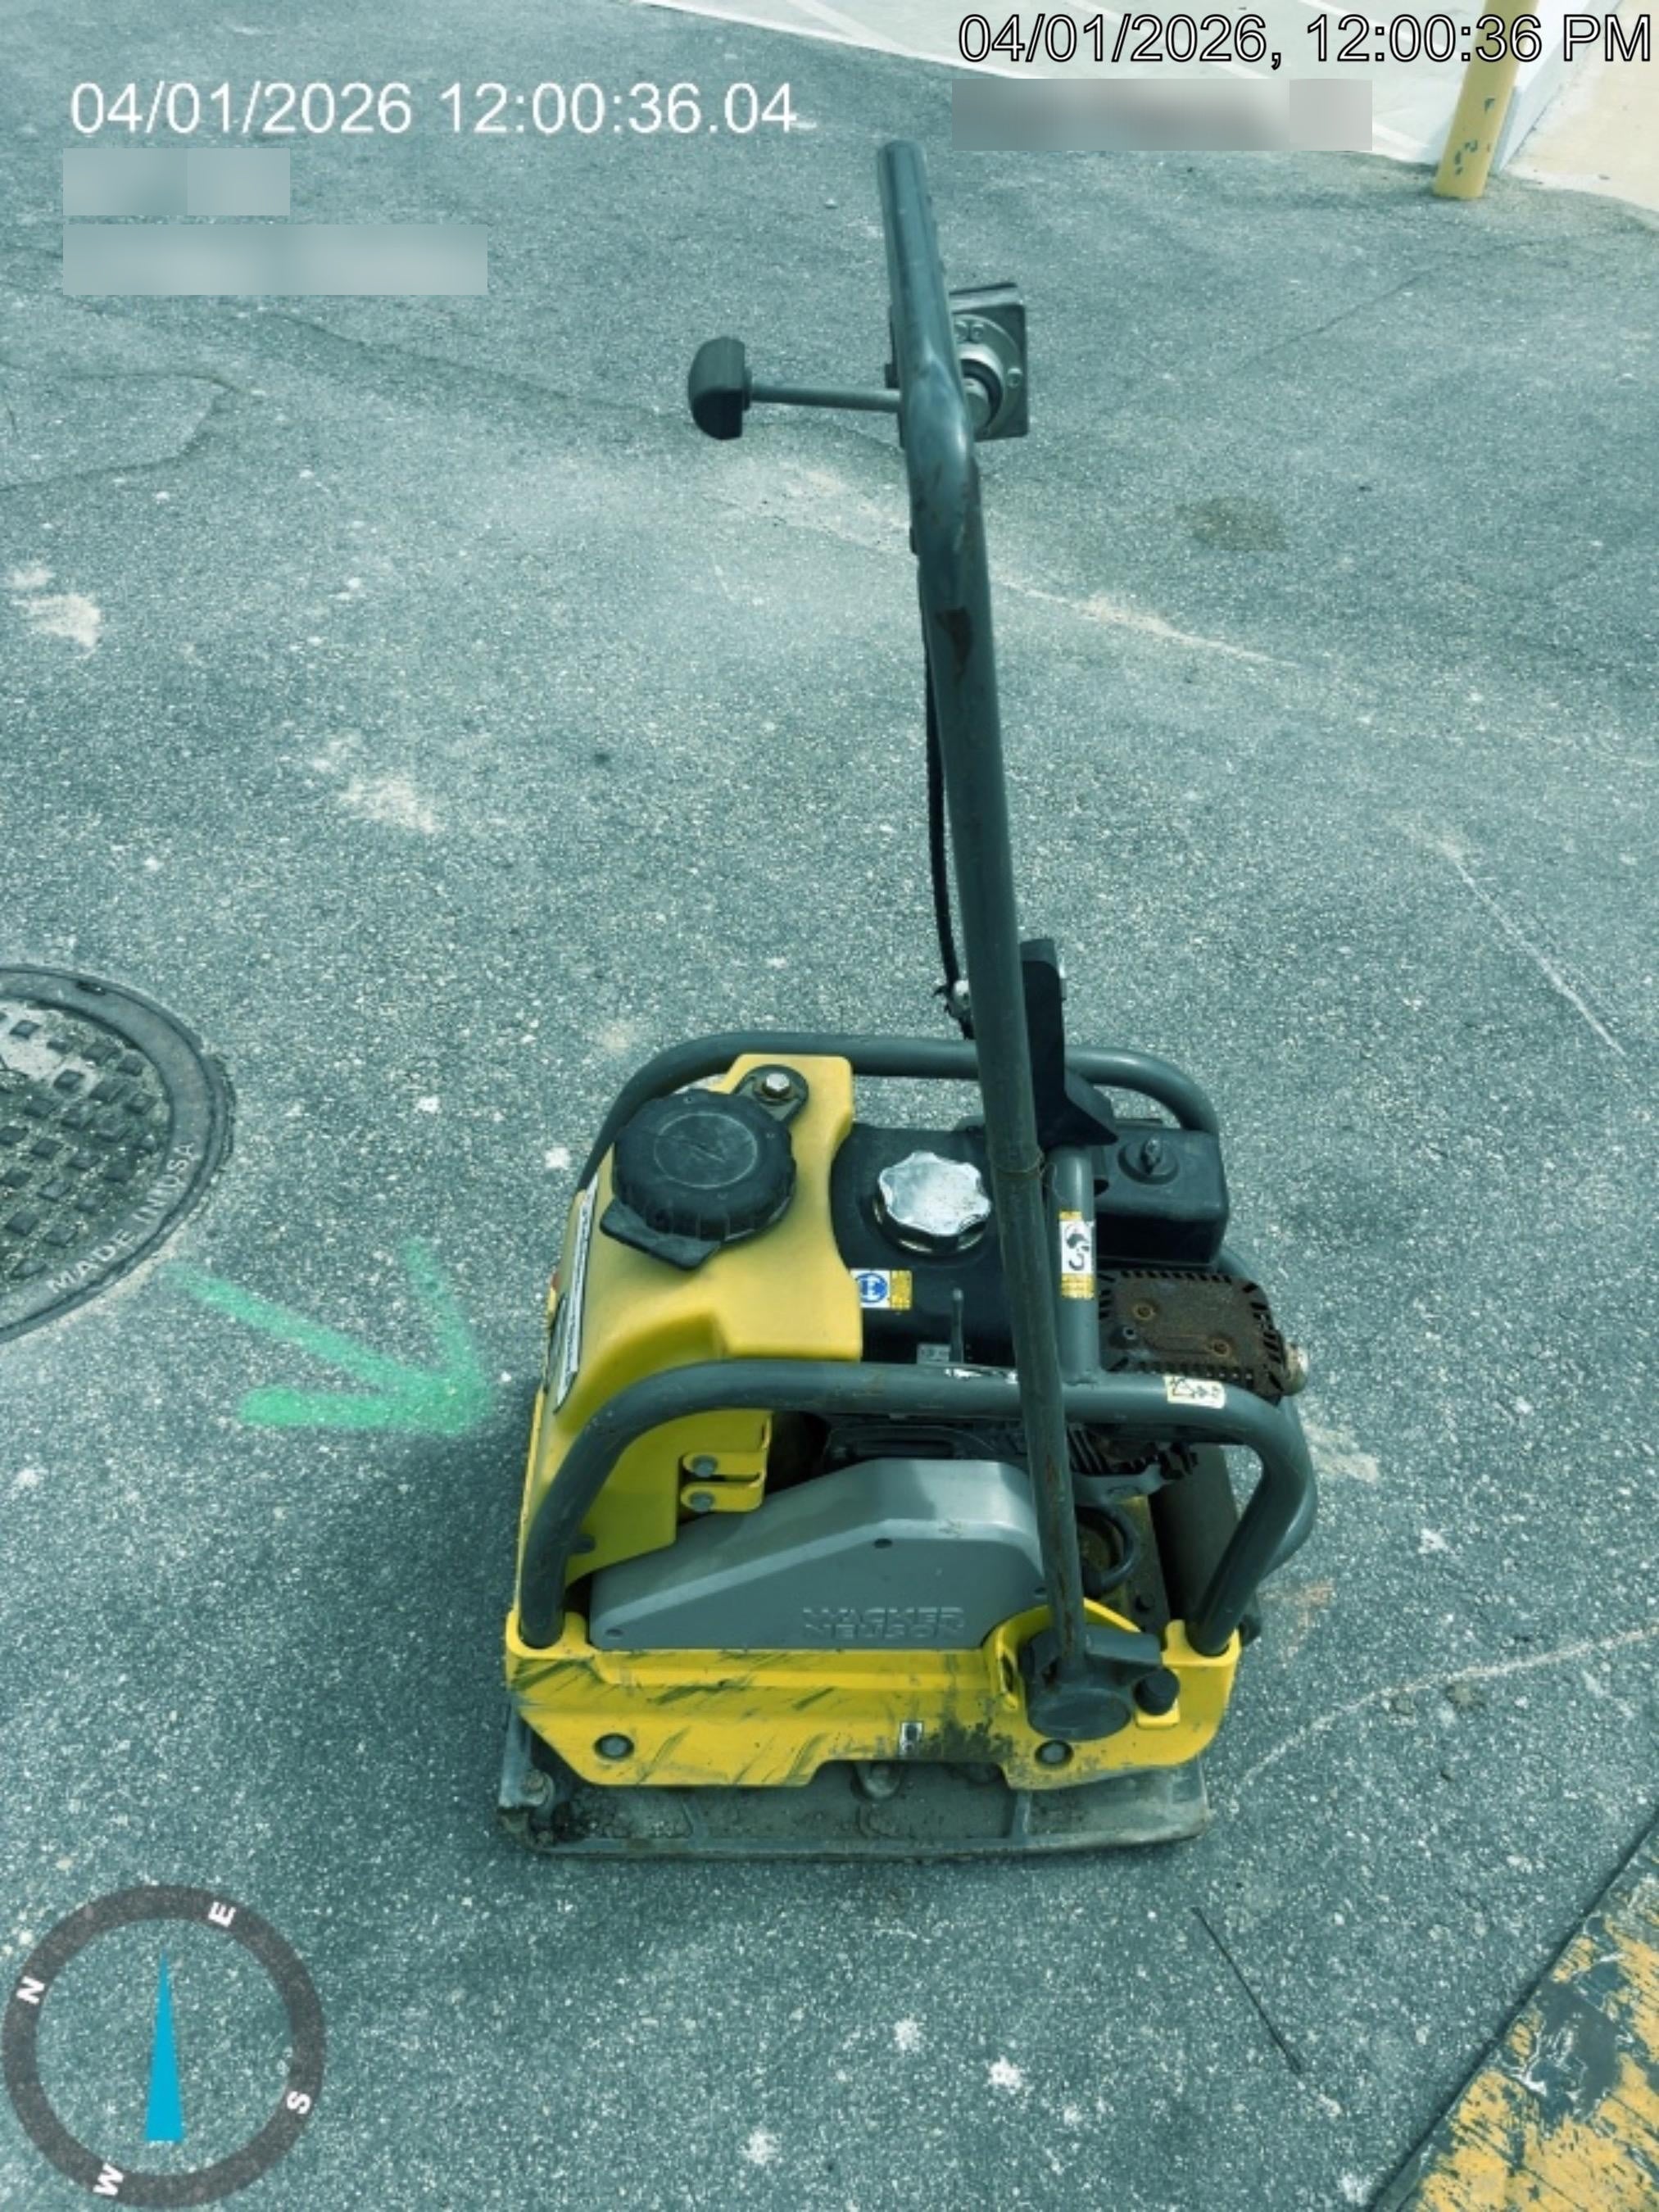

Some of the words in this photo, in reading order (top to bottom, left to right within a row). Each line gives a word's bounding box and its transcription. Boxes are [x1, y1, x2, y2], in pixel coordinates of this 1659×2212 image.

[45, 1229, 134, 1293] MADE
[130, 1188, 169, 1225] IN
[156, 1142, 202, 1188] USA
